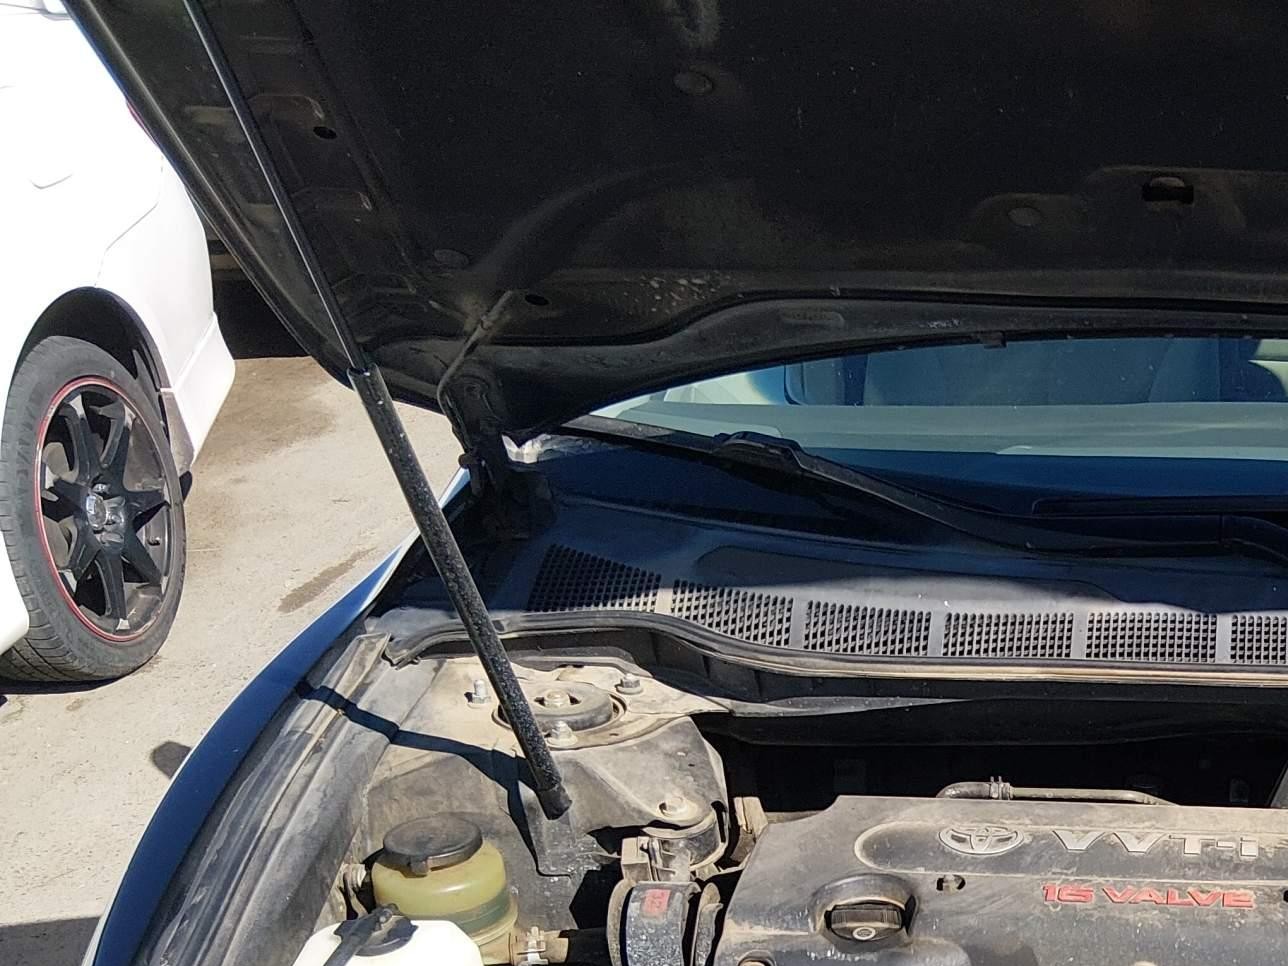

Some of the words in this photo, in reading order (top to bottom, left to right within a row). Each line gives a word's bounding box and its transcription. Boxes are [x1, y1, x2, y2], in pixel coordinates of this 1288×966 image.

[1052, 829, 1259, 858] VVT-i
[1042, 883, 1096, 904] 16
[1102, 885, 1256, 909] VALVE
